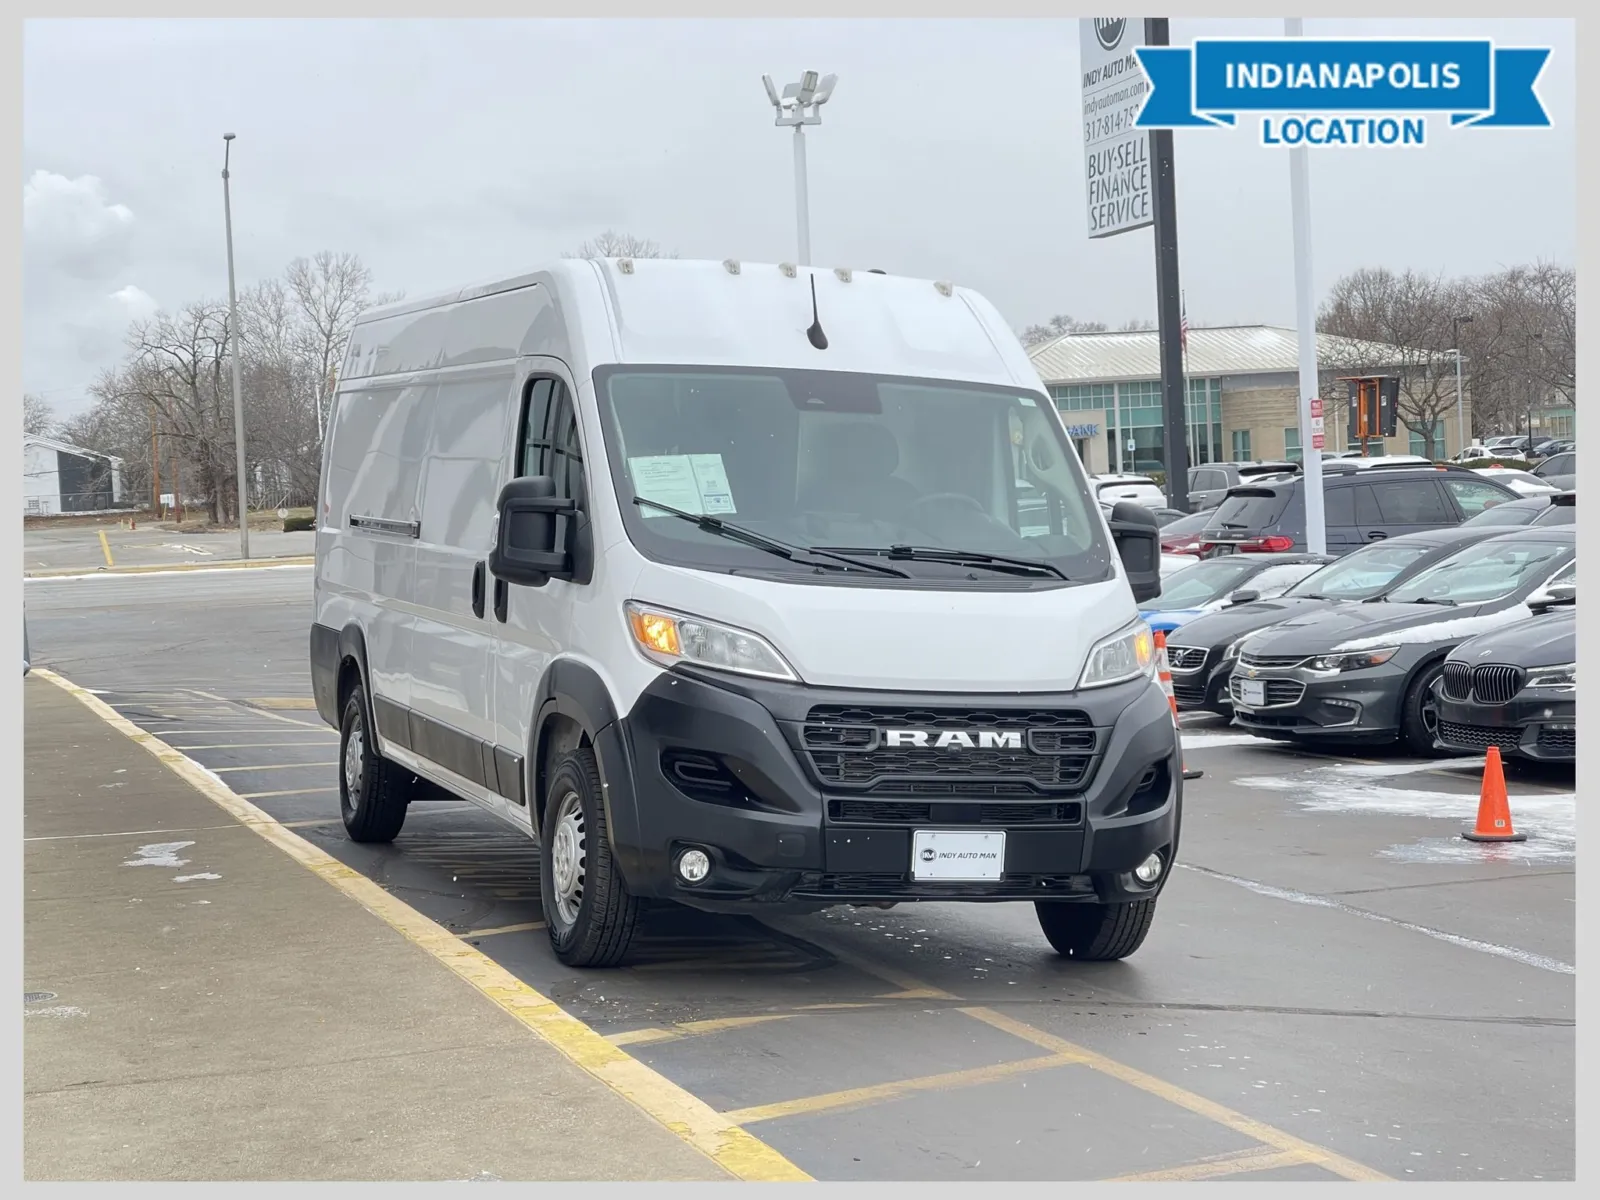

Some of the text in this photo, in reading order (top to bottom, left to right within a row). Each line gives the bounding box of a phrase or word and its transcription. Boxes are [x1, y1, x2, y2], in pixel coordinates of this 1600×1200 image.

[1083, 54, 1138, 88] INDY AUTO MA
[1084, 81, 1145, 116] indyautoman.com
[1089, 163, 1148, 206] FINANCE
[1091, 191, 1148, 231] SERVICE
[886, 729, 1022, 749] RAM
